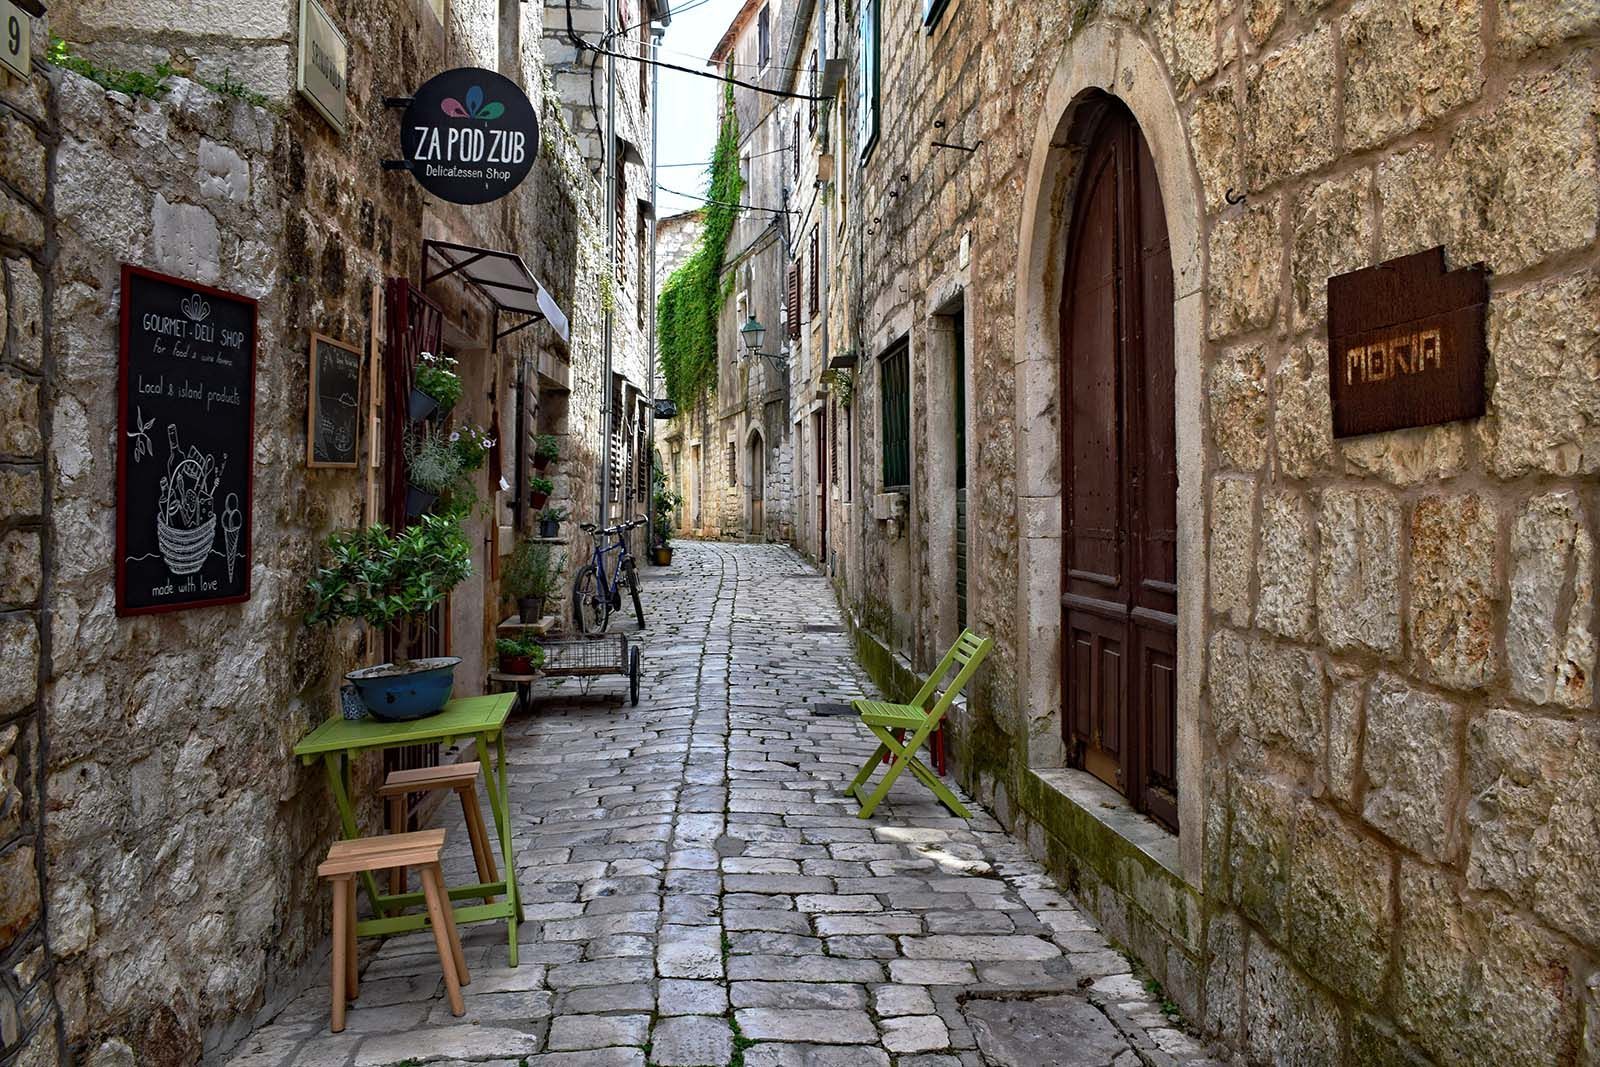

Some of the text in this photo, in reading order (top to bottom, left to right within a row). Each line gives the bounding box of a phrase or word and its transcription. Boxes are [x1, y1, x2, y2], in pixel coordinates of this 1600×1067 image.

[8, 16, 20, 55] 9
[414, 127, 525, 164] ZA POD ZUB
[426, 164, 511, 181] Delicatessen Shop
[143, 313, 187, 338] GOURMET
[220, 329, 244, 349] SHOP
[138, 375, 240, 412] Local & island products
[152, 575, 218, 597] made with love
